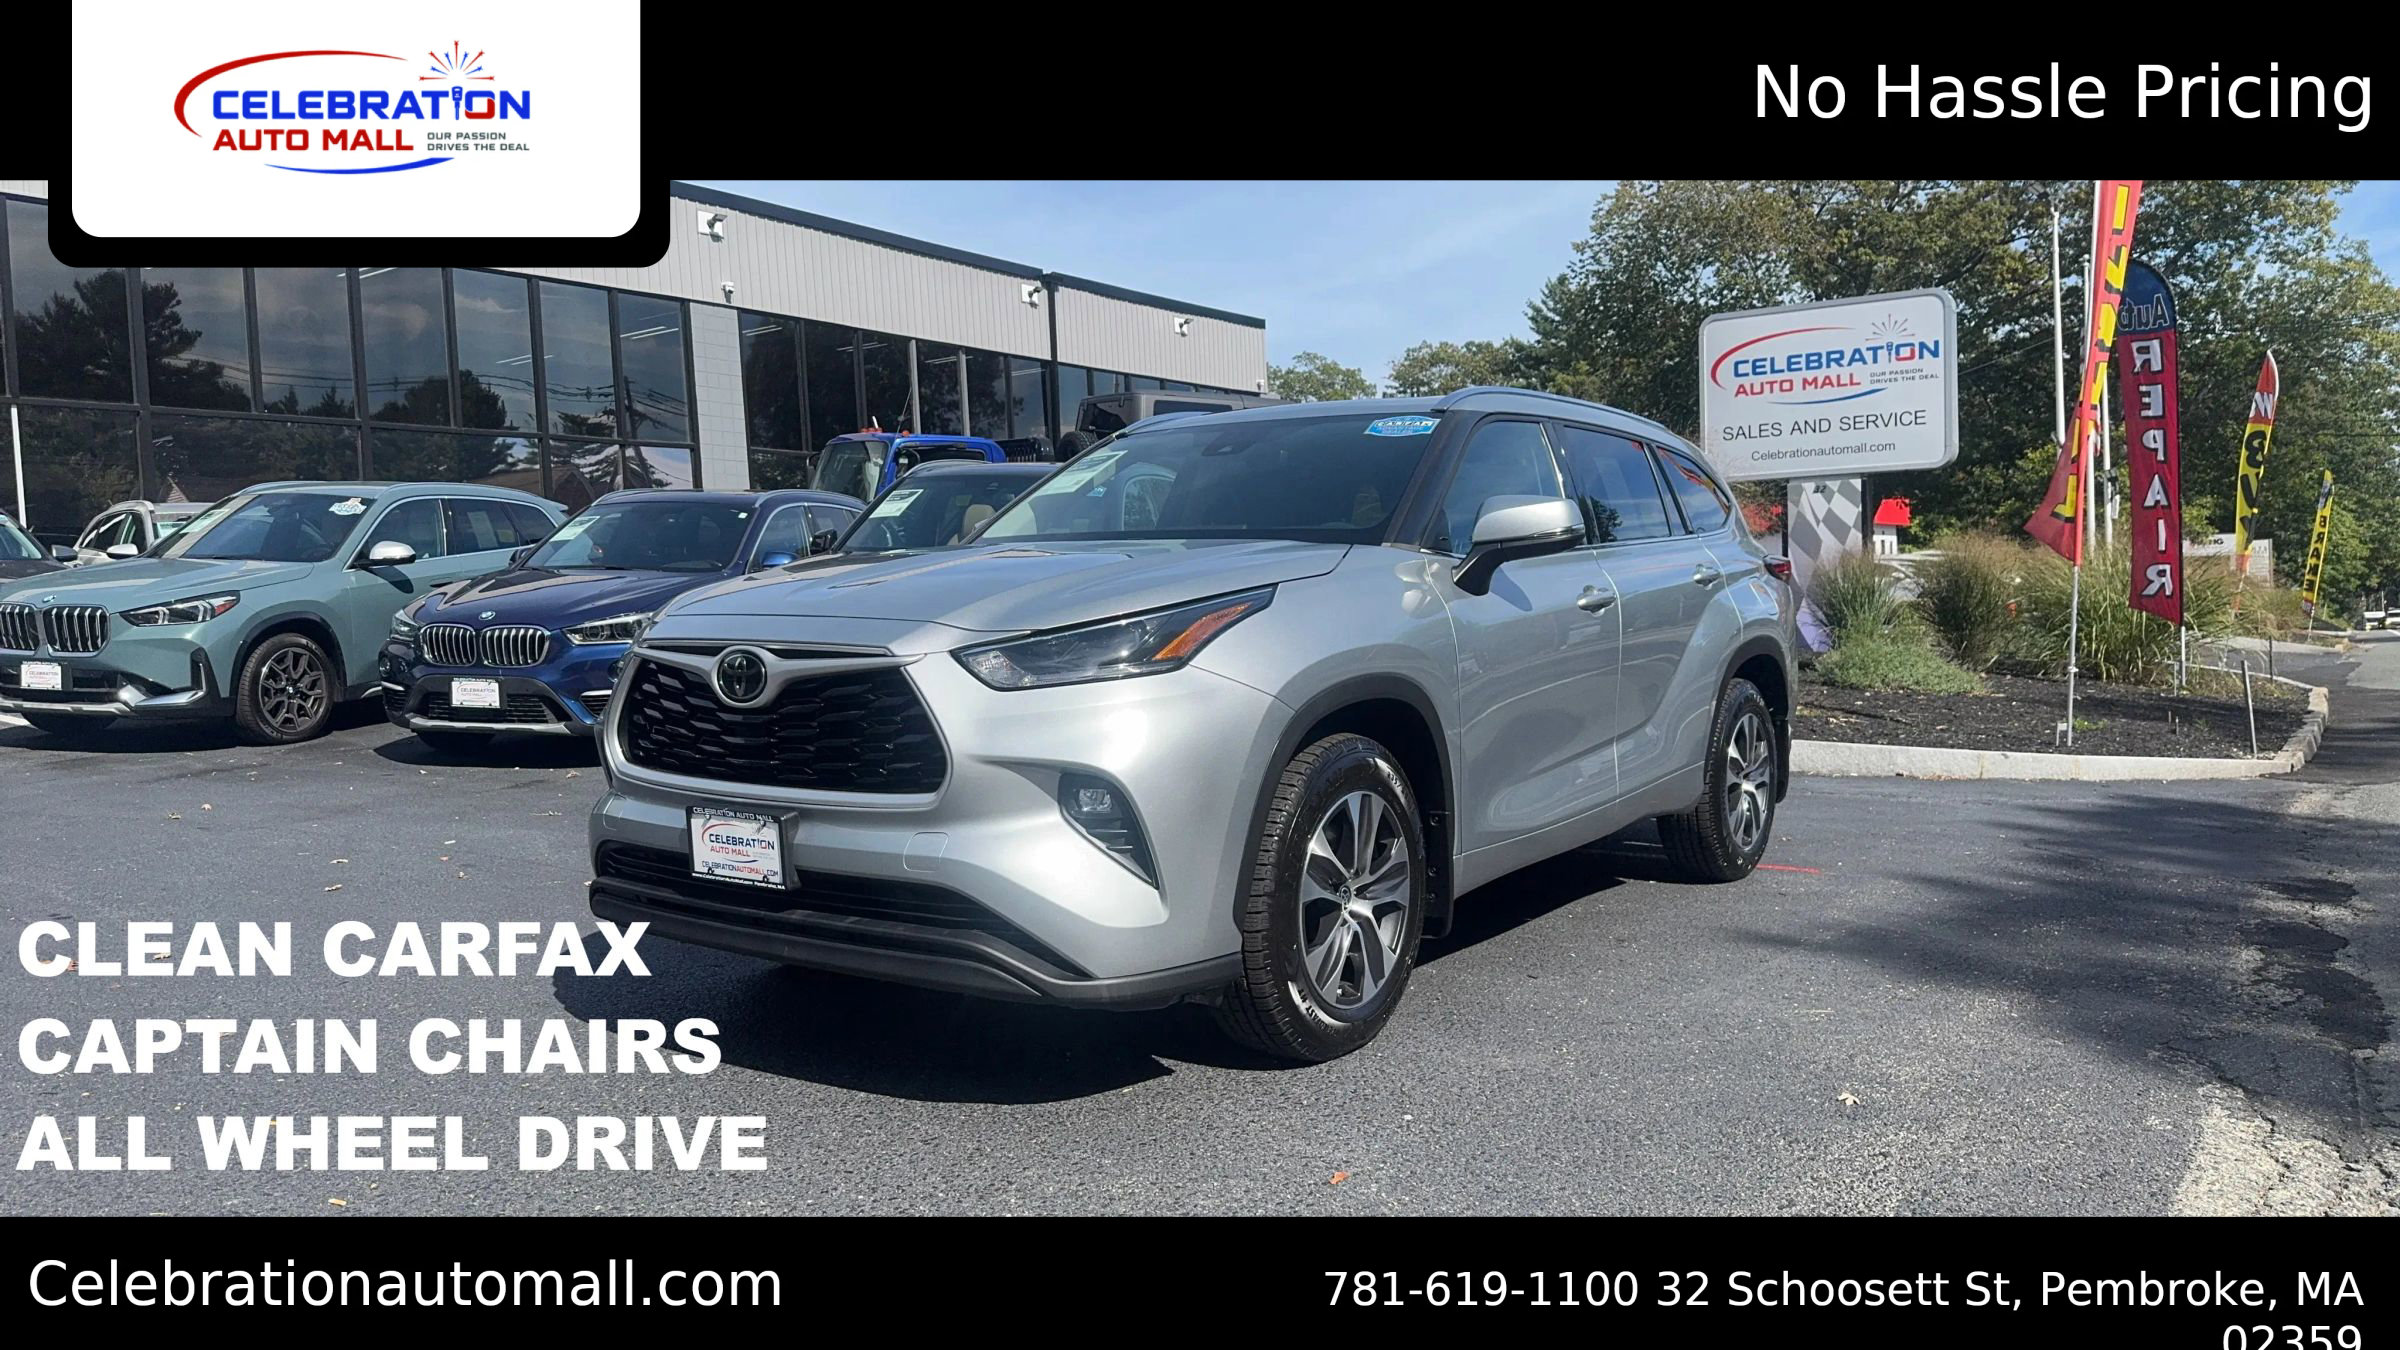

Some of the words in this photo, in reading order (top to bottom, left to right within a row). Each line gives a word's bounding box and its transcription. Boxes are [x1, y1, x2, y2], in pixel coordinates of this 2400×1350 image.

[1733, 339, 1940, 378] CELEBRATION
[1870, 377, 1899, 385] DRIVES
[1919, 373, 1940, 381] DEAL
[1889, 368, 1924, 376] PASSION
[1734, 379, 1794, 398] AUTO
[1802, 372, 1861, 392] MALL
[1722, 421, 1783, 442] SALES
[1790, 418, 1832, 437] AND
[1839, 410, 1927, 432] SERVICE
[1751, 441, 1896, 462] Celebrationautomall.com
[736, 812, 754, 820] AUTO
[709, 833, 775, 851] CELEBRATION
[710, 845, 730, 855] AUTO
[731, 848, 751, 857] MALL
